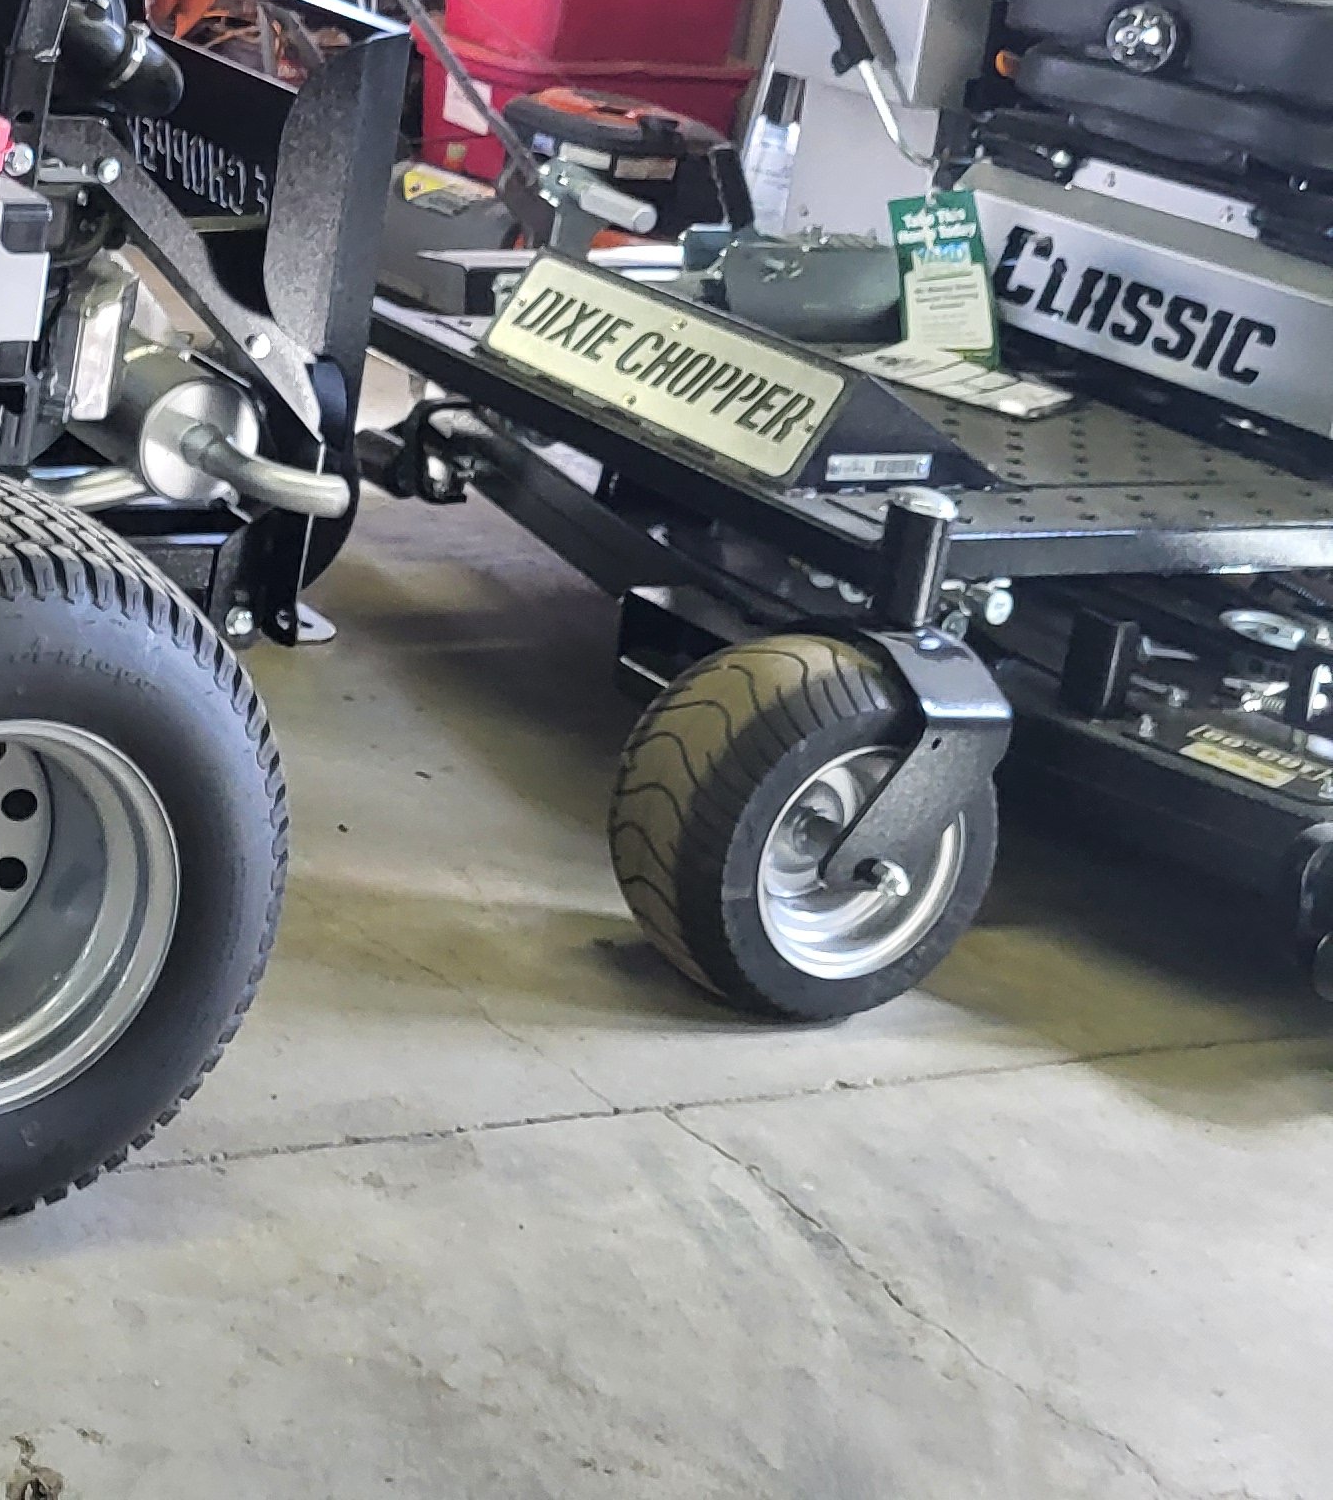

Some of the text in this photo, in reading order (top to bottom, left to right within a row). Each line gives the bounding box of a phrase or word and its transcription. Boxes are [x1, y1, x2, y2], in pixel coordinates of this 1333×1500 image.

[512, 287, 817, 444] DIXIE CHOPPER
[992, 225, 1276, 386] CLASSIC
